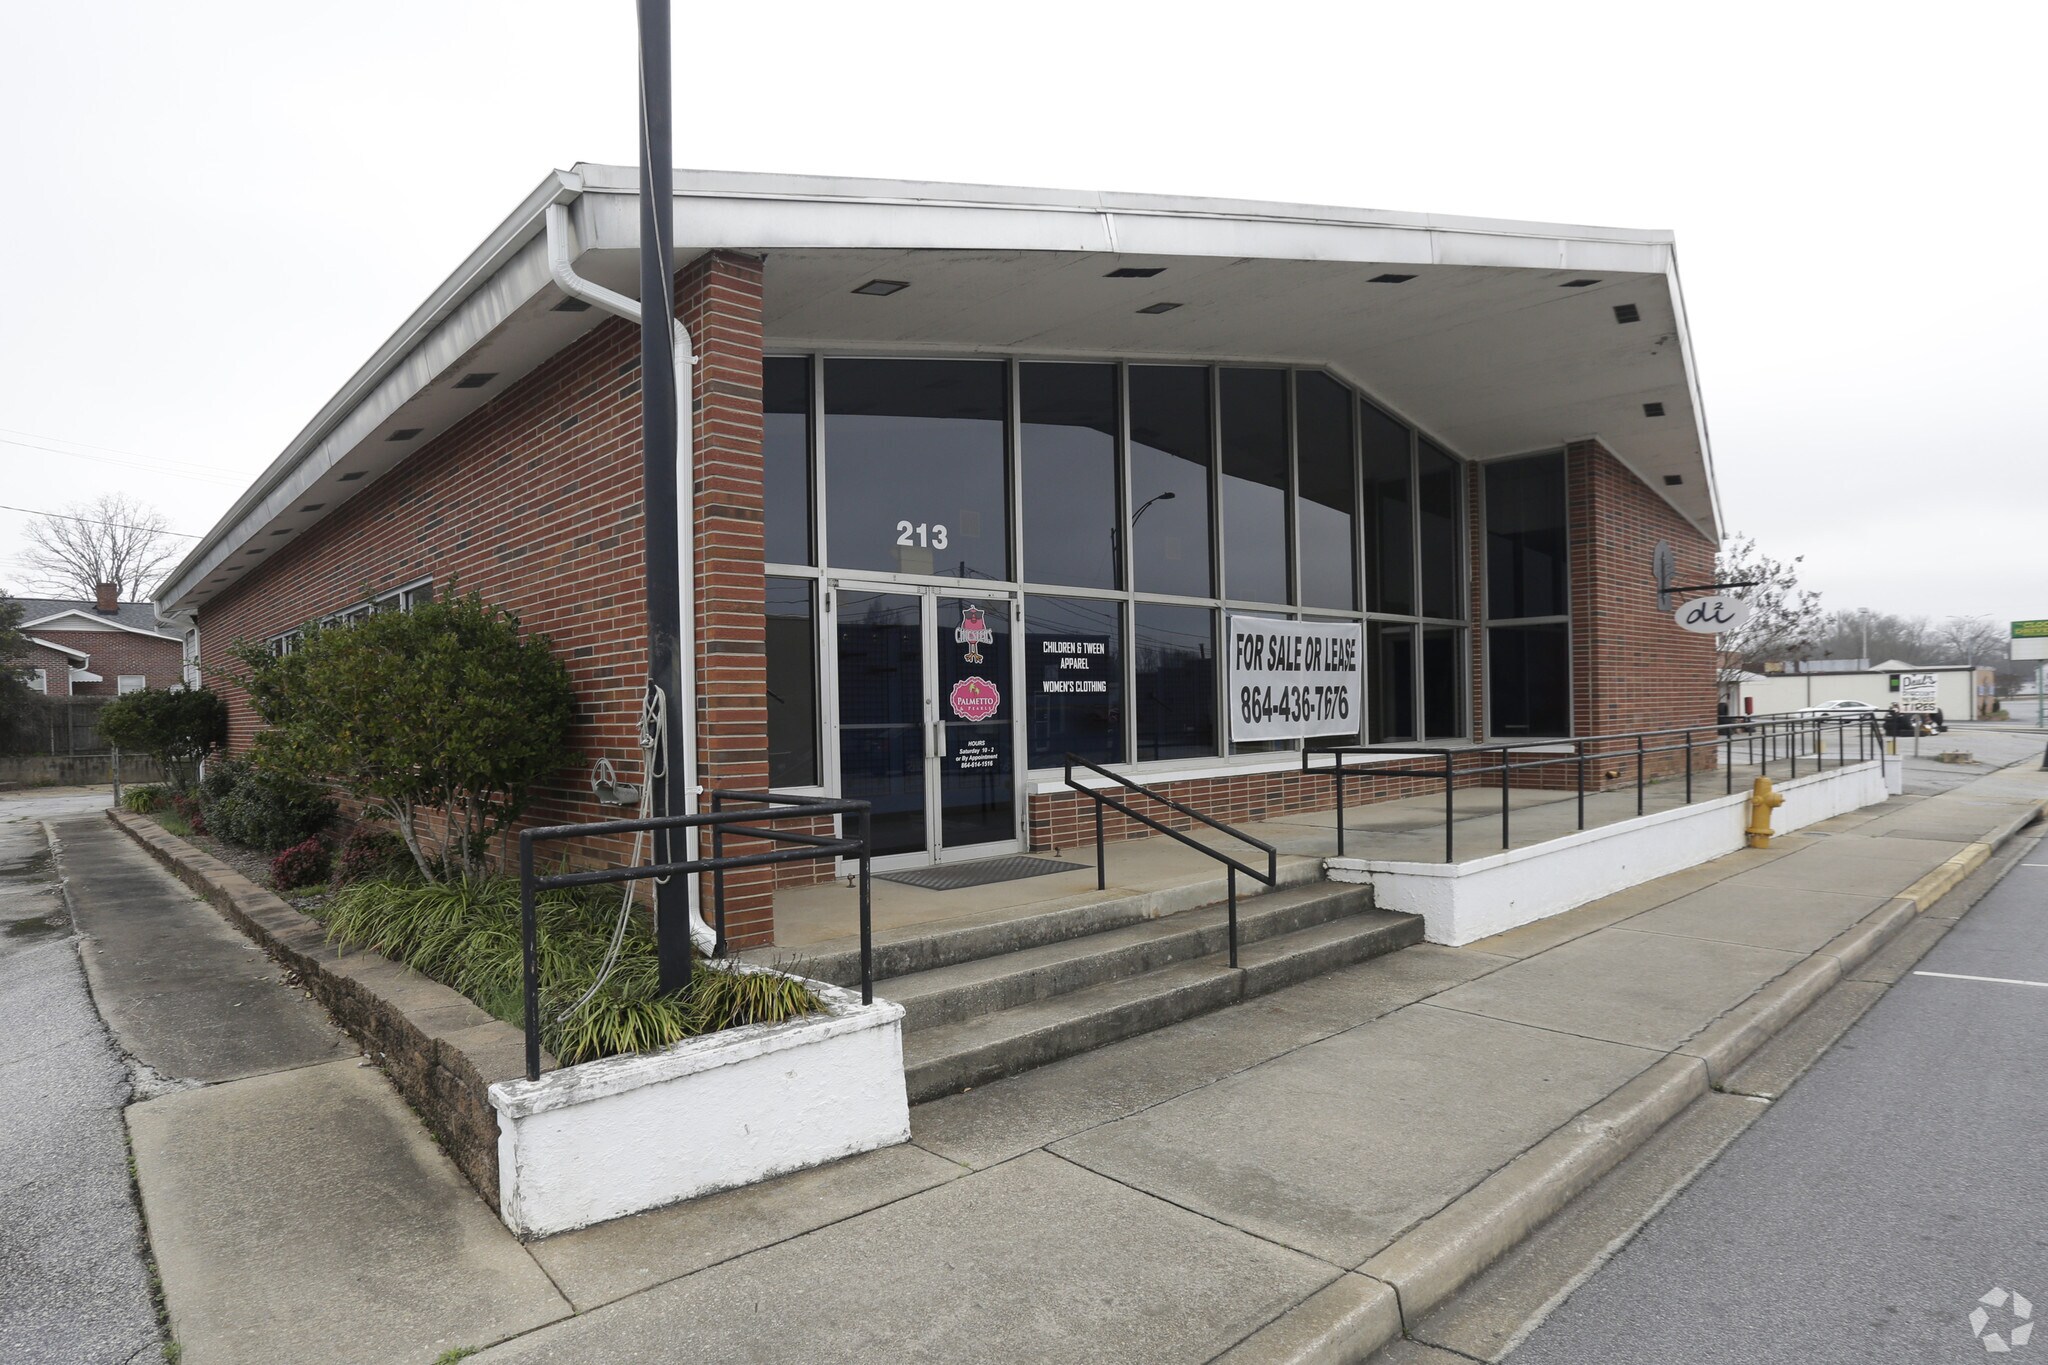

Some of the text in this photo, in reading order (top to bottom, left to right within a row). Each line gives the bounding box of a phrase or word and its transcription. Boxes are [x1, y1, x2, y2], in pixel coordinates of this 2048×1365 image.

[896, 520, 948, 550] 213
[1043, 641, 1105, 655] CHILDREN & TWEEN
[1236, 633, 1356, 672] FOR SALE OR LEASE
[1060, 657, 1090, 670] APPAREL
[1043, 680, 1107, 693] WOMEN'S CLOTHING
[957, 697, 994, 705] PALMETTO
[1240, 685, 1349, 724] 864-436-7676
[1902, 702, 1936, 711] TIRES
[961, 755, 969, 763] By
[968, 753, 998, 761] Appointment
